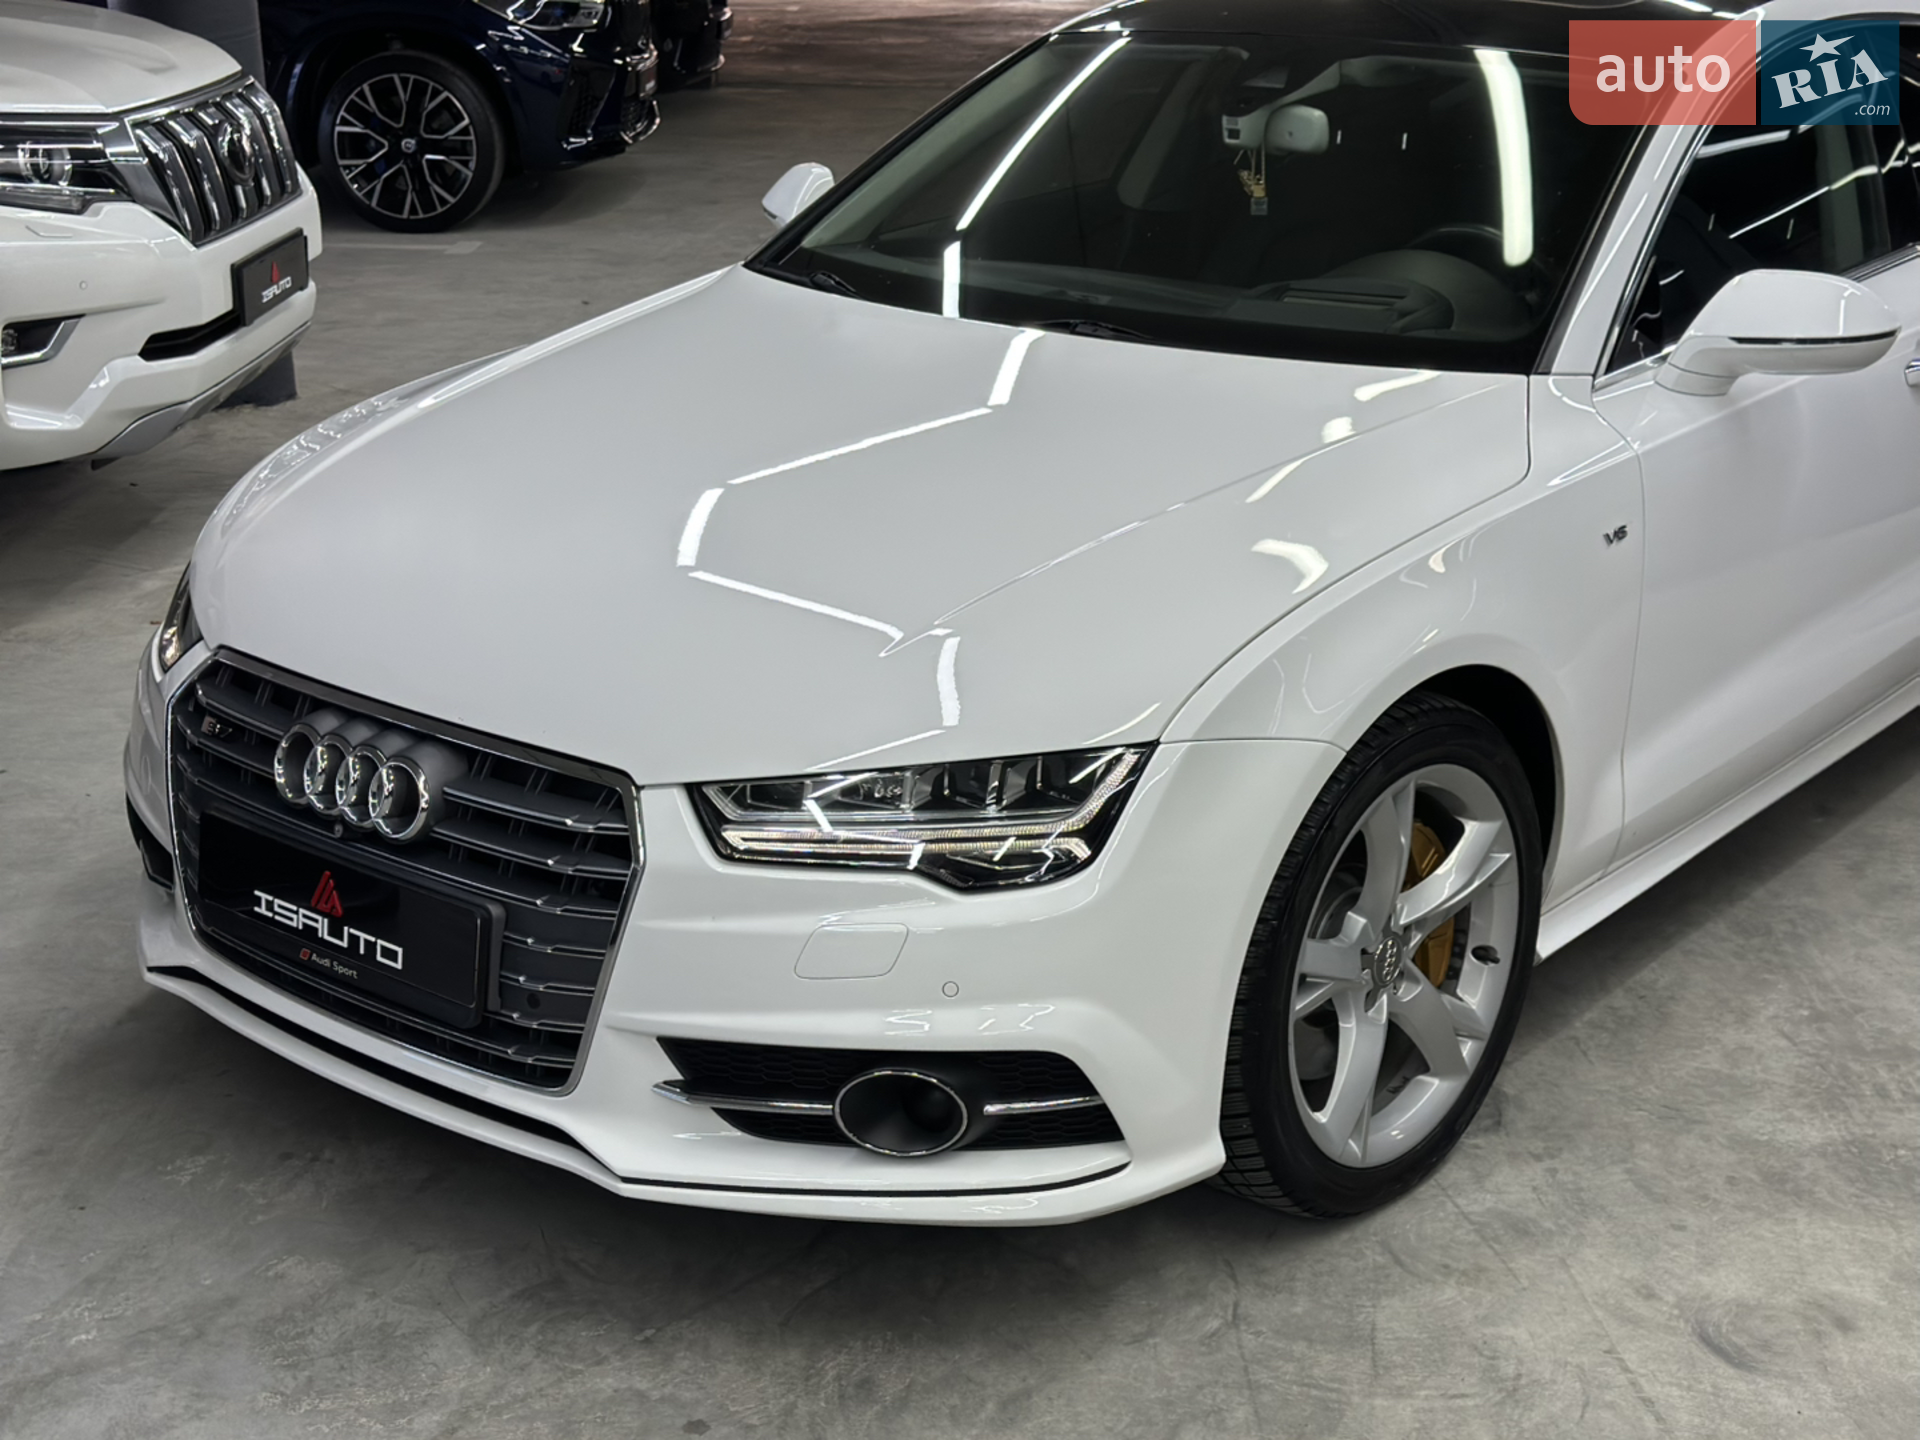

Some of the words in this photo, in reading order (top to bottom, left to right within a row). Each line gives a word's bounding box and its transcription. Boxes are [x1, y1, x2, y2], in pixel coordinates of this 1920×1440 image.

[253, 889, 404, 970] ISAUTO
[311, 952, 331, 967] Audi
[333, 960, 358, 979] Sport
